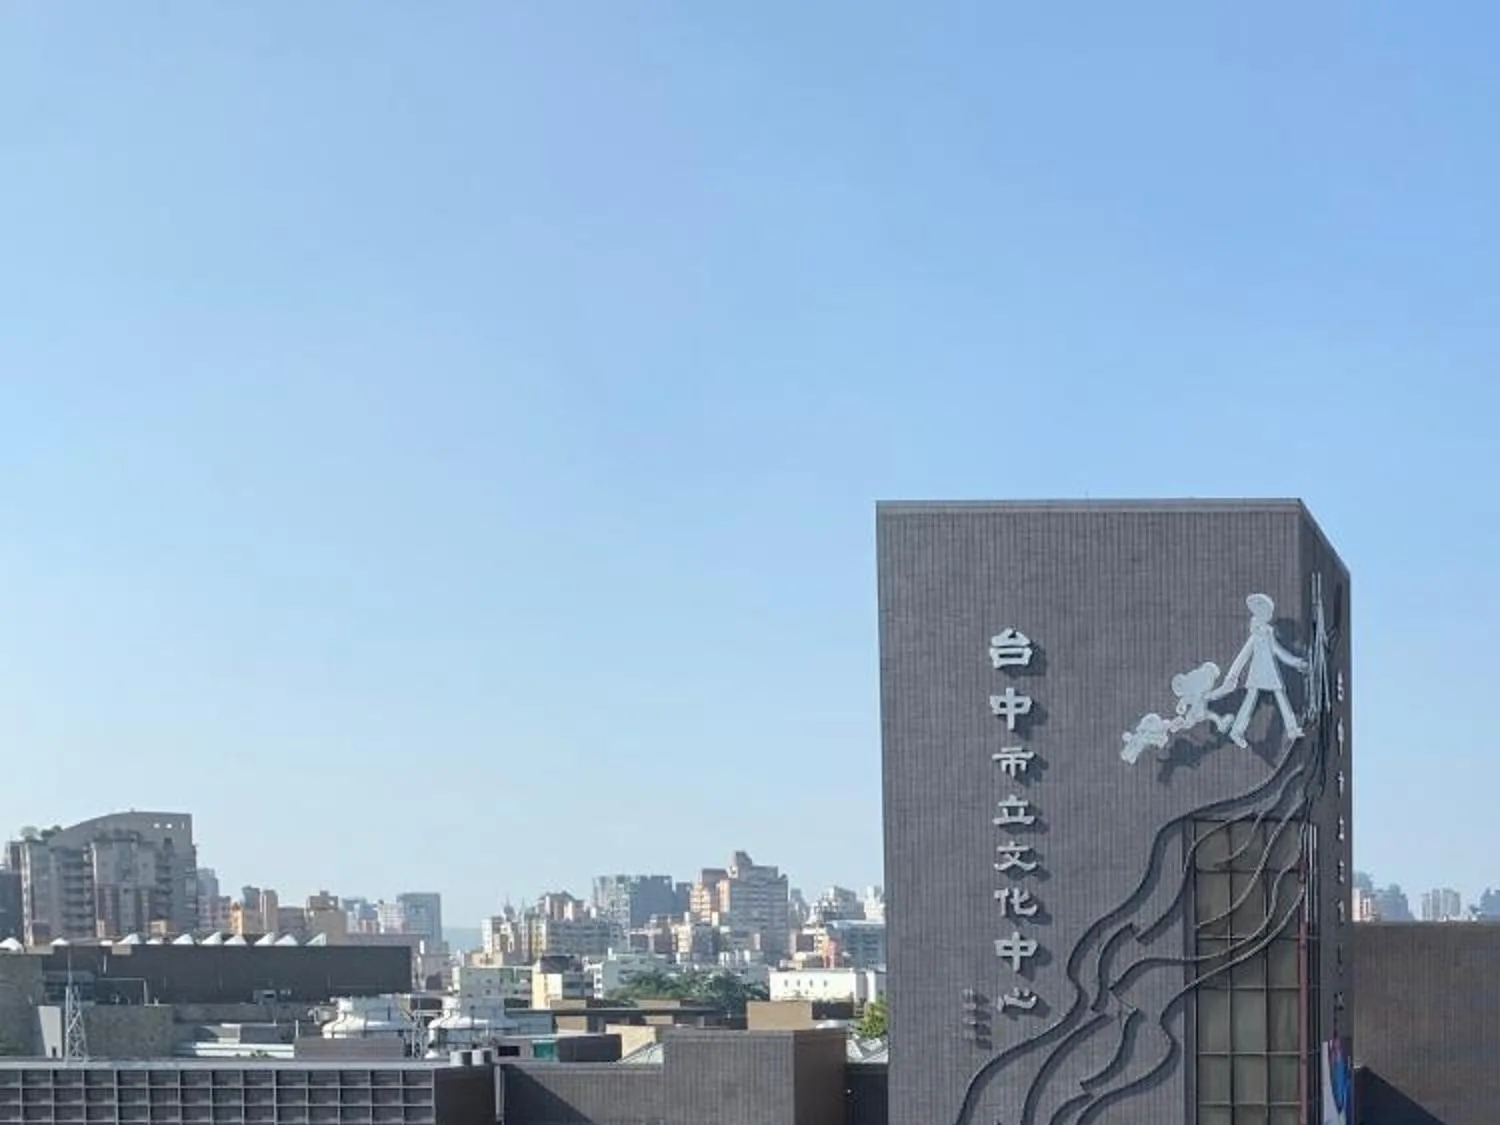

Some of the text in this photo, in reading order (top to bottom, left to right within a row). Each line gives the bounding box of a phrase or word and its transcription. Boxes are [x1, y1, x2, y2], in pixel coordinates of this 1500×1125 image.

[988, 628, 1037, 1012] 台中市立文化中心
